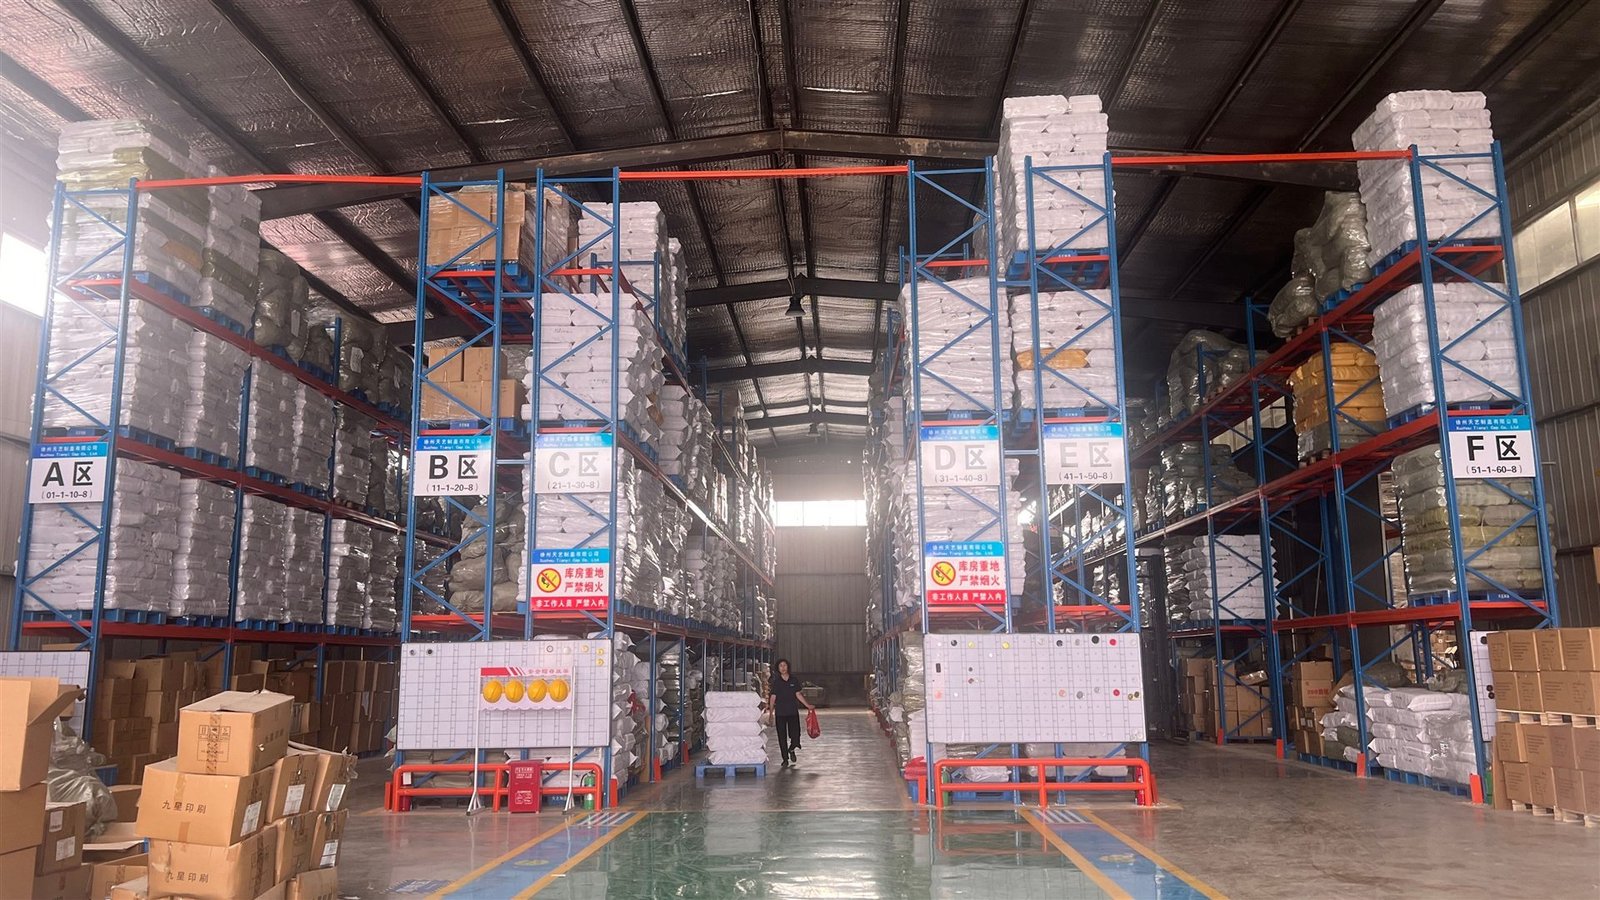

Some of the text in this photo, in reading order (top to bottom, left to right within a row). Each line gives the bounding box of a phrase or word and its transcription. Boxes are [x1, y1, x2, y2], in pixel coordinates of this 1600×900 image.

[959, 560, 1000, 572] 库房重地
[565, 567, 604, 578] 库房重地
[960, 575, 1000, 586] 严禁烟火
[564, 582, 603, 592] 严禁烟火
[536, 599, 604, 607] 非工作人员 严禁入内
[162, 800, 207, 814] 九星印刷
